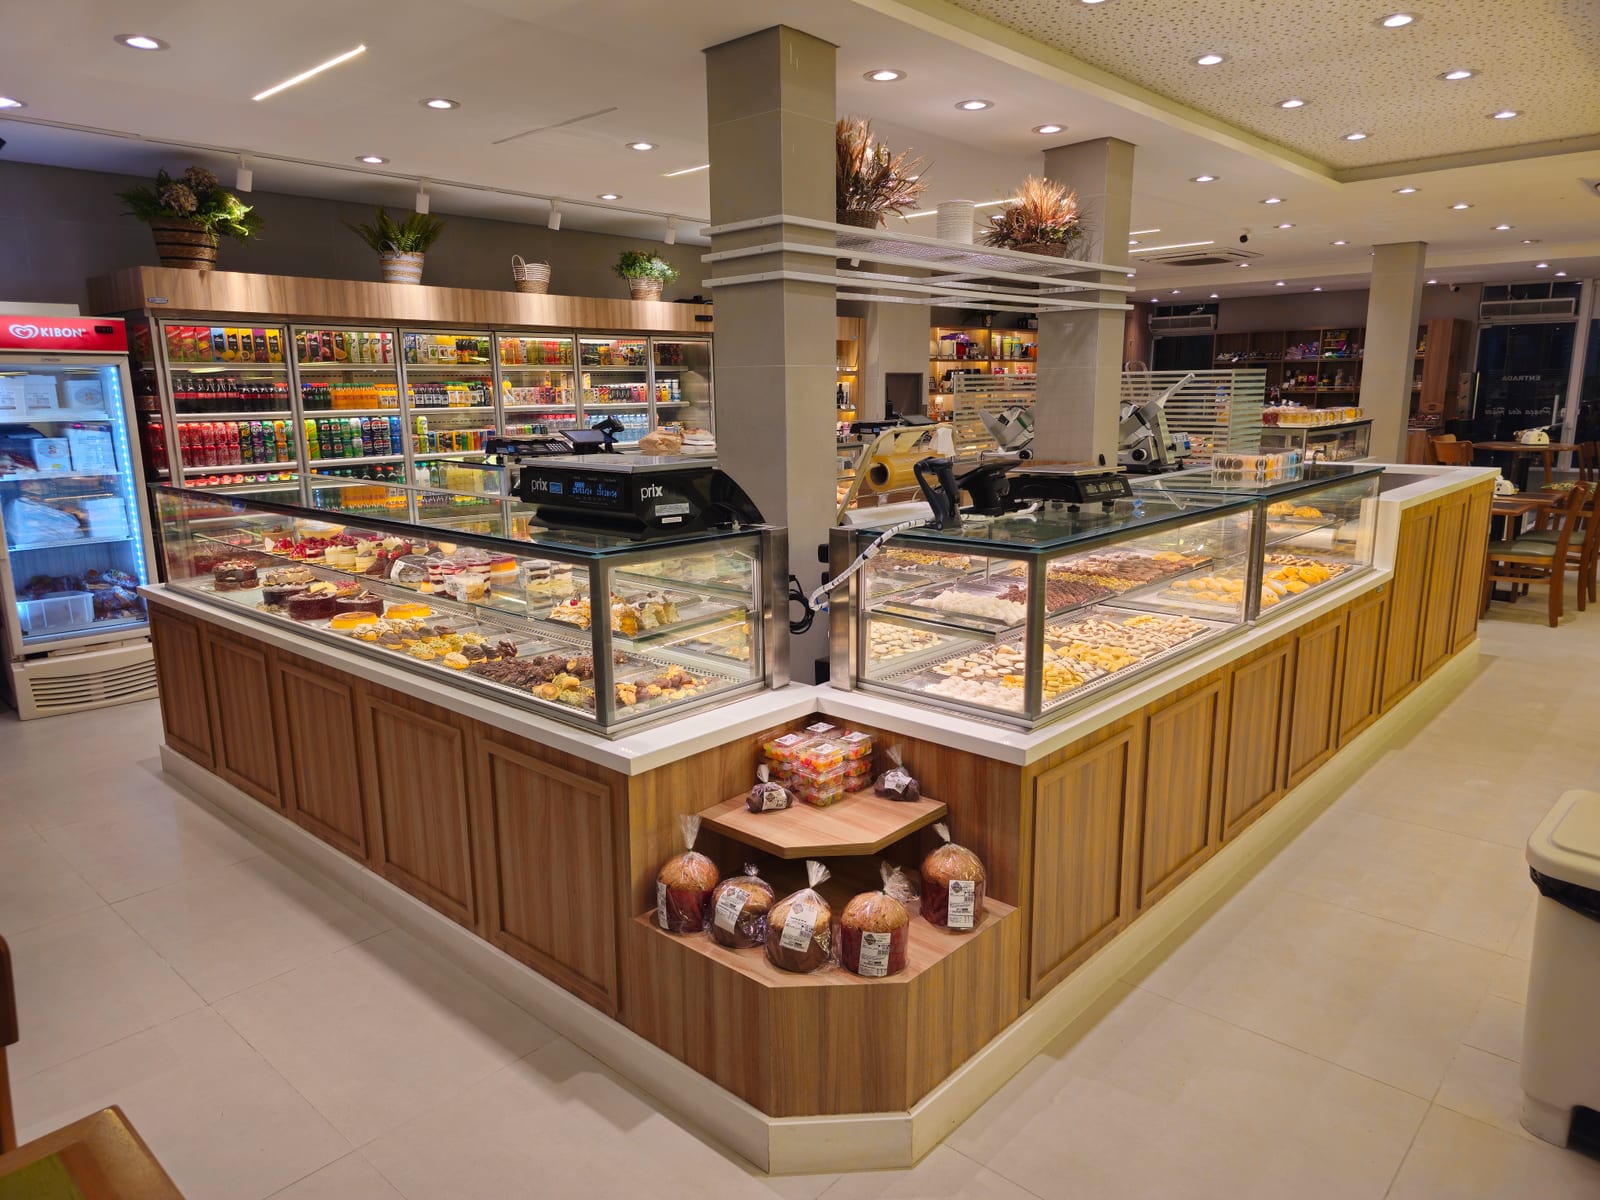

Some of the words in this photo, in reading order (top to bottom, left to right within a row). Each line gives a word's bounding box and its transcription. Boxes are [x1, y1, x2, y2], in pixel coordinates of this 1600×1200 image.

[40, 327, 83, 338] KIBON
[531, 477, 548, 493] prix
[640, 483, 664, 502] prix
